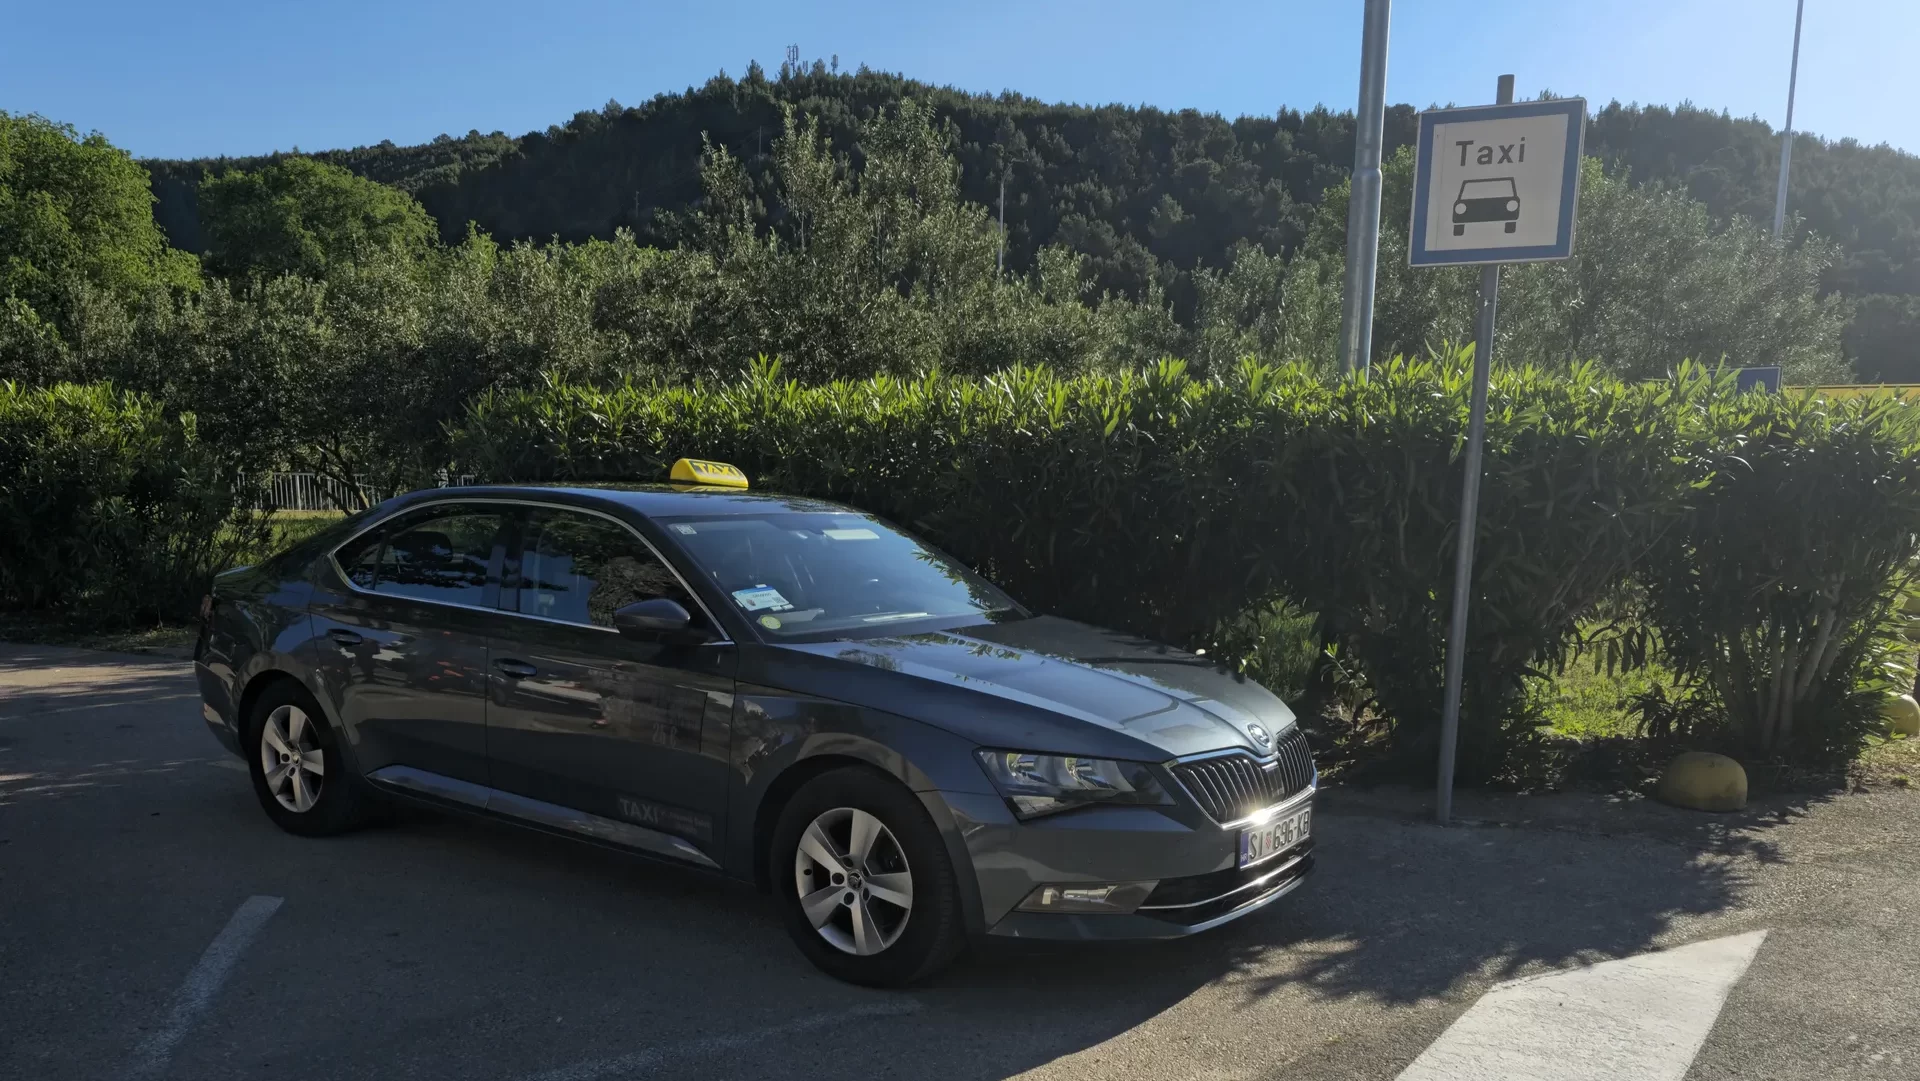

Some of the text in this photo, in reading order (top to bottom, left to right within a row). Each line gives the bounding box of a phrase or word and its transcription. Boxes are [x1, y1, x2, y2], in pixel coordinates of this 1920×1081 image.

[1455, 136, 1526, 167] Taxi
[692, 462, 740, 477] TAXI
[619, 798, 659, 824] TAXI
[1249, 810, 1310, 860] SI 696-KB
